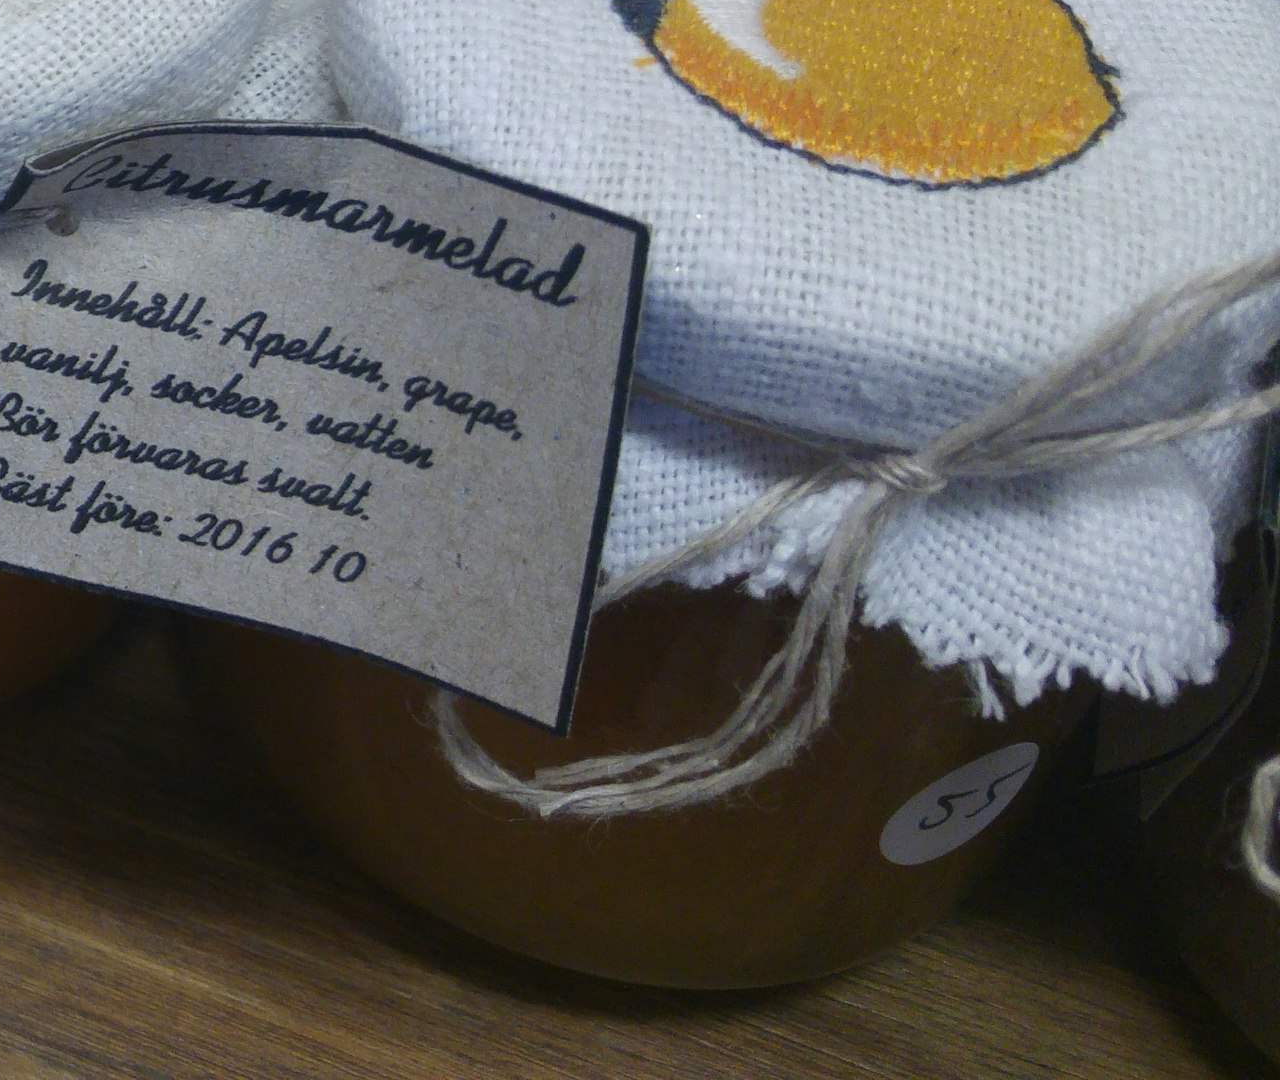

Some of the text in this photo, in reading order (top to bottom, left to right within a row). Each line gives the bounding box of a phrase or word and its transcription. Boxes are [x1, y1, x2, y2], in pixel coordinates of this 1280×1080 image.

[61, 152, 586, 310] Citrusmarmelad
[0, 340, 434, 471] vanilj, socker, vatten
[10, 258, 525, 442] Innehåll: Apelsin, grape,
[65, 411, 249, 487] förvaras
[256, 469, 372, 522] svalt.
[70, 480, 174, 539] före:
[178, 511, 294, 565] 2016
[306, 541, 368, 585] 10
[918, 762, 1034, 831] 55
